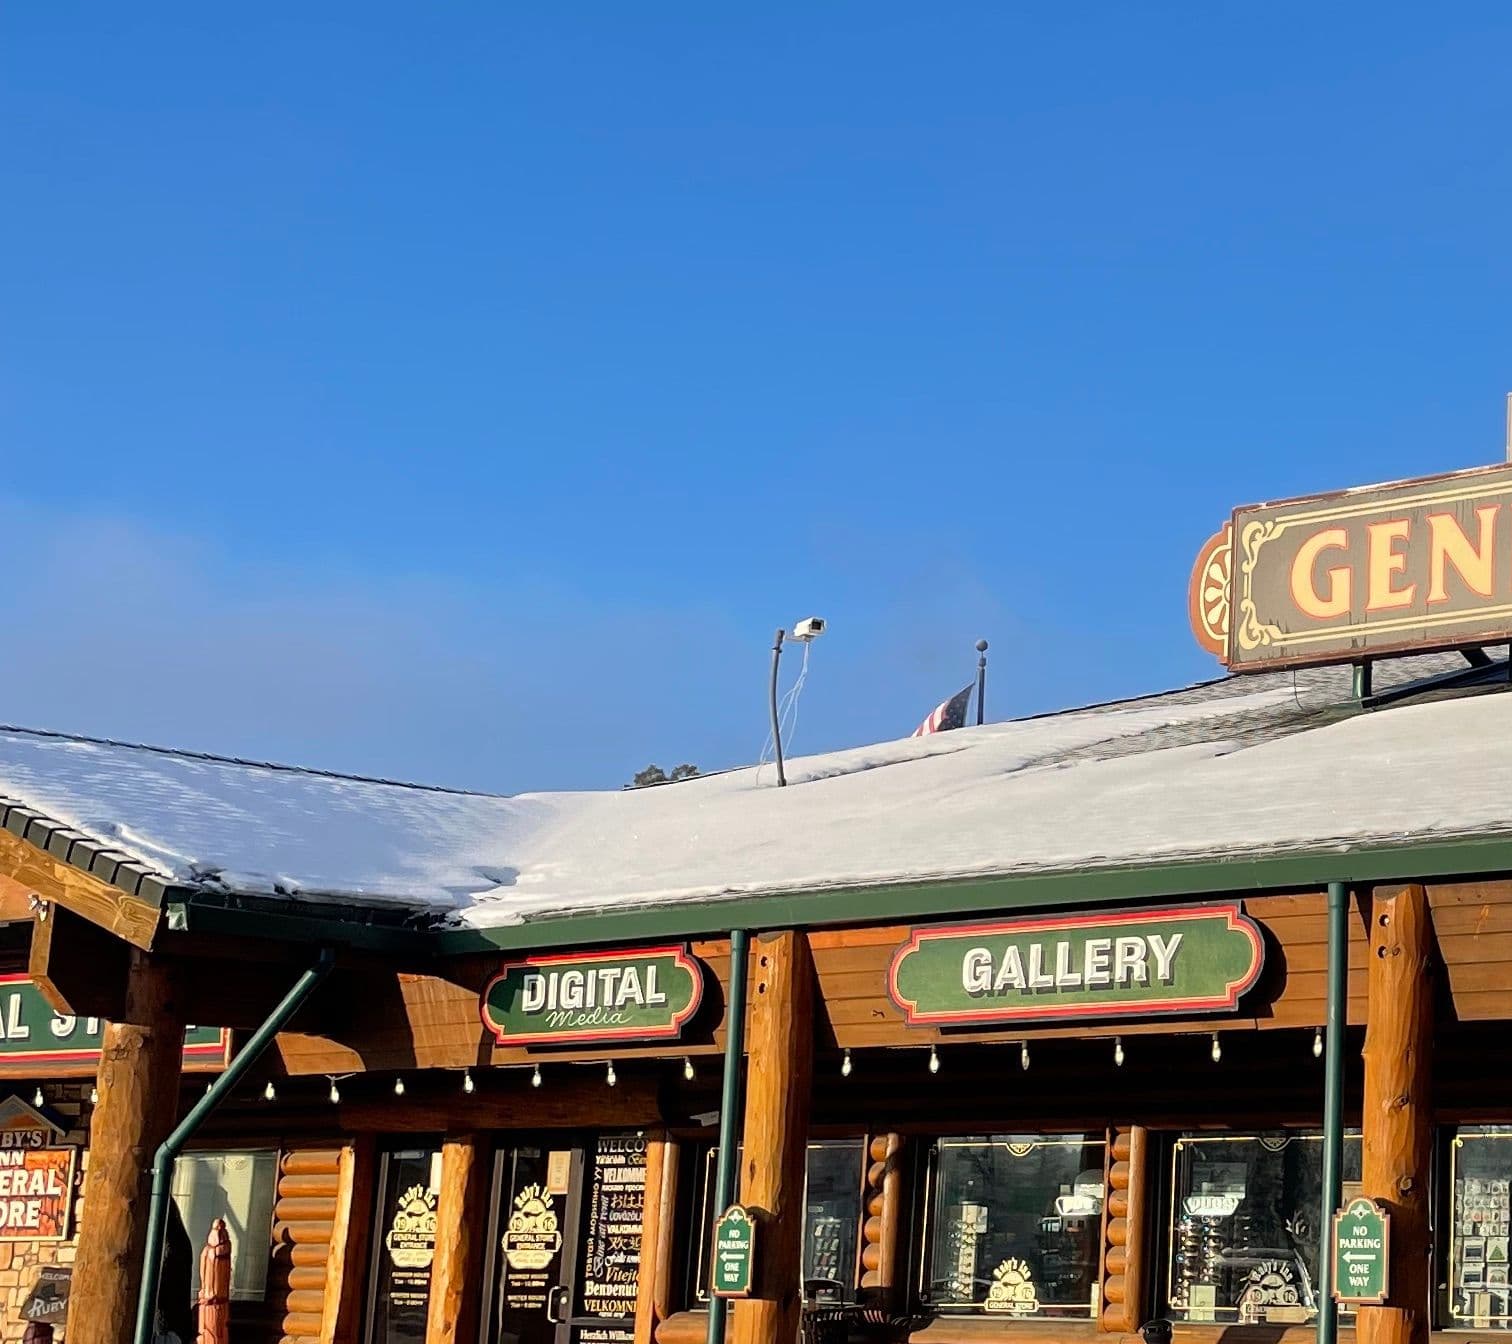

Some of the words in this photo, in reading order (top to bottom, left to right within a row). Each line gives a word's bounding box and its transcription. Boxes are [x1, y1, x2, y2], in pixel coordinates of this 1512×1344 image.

[962, 933, 1184, 994] GALLERY
[521, 965, 666, 1012] DIGITAL
[545, 1006, 633, 1028] Media
[597, 1139, 647, 1153] WELCO
[728, 1229, 741, 1239] NO
[1352, 1226, 1368, 1236] NO
[718, 1240, 749, 1249] PARKING
[1339, 1239, 1381, 1249] PARKING
[724, 1262, 740, 1272] ONE
[1349, 1264, 1370, 1274] ONE
[723, 1273, 740, 1283] WAY
[1348, 1276, 1370, 1287] WAY
